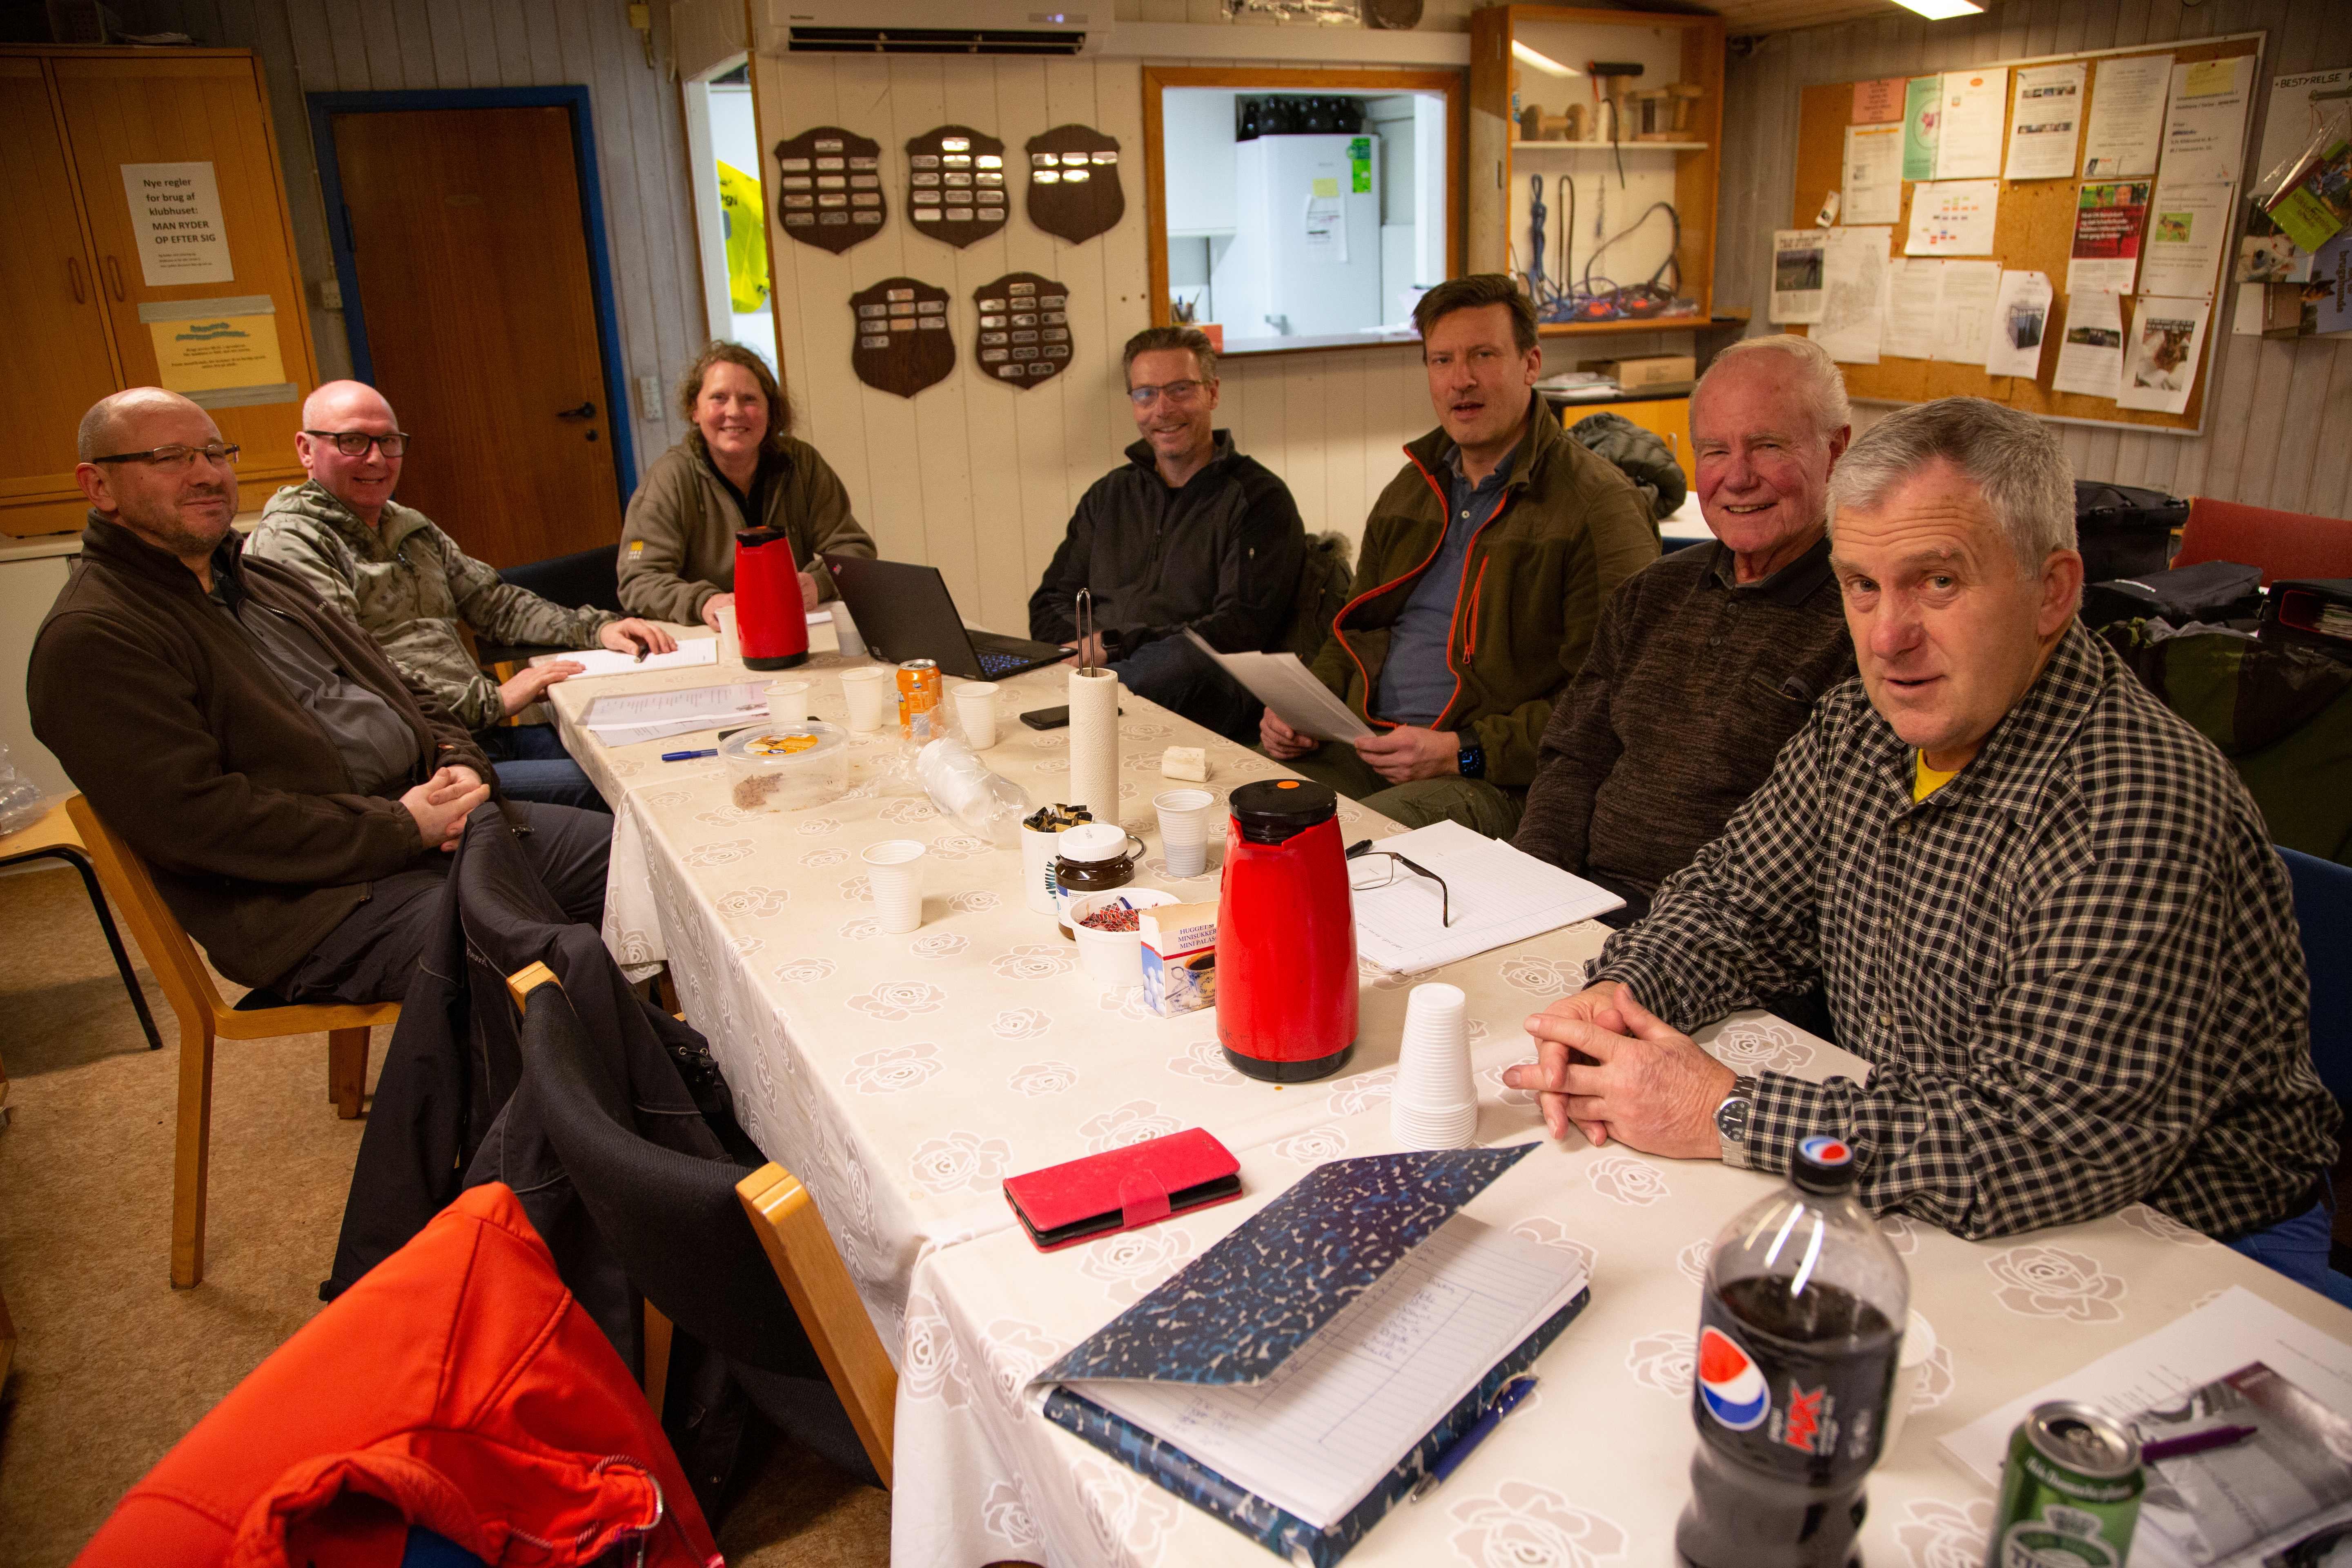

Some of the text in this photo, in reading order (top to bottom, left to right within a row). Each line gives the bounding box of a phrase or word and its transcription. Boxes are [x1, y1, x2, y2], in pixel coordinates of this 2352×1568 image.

[2280, 73, 2342, 88] BESTYRELSE
[143, 178, 191, 189] Nye regler
[146, 192, 195, 203] for brug af
[149, 207, 198, 216] klubhuset:
[152, 220, 209, 230] MAN RYDER
[155, 233, 216, 244] OP EFTER SIG
[1180, 936, 1216, 949] MINI PALAS
